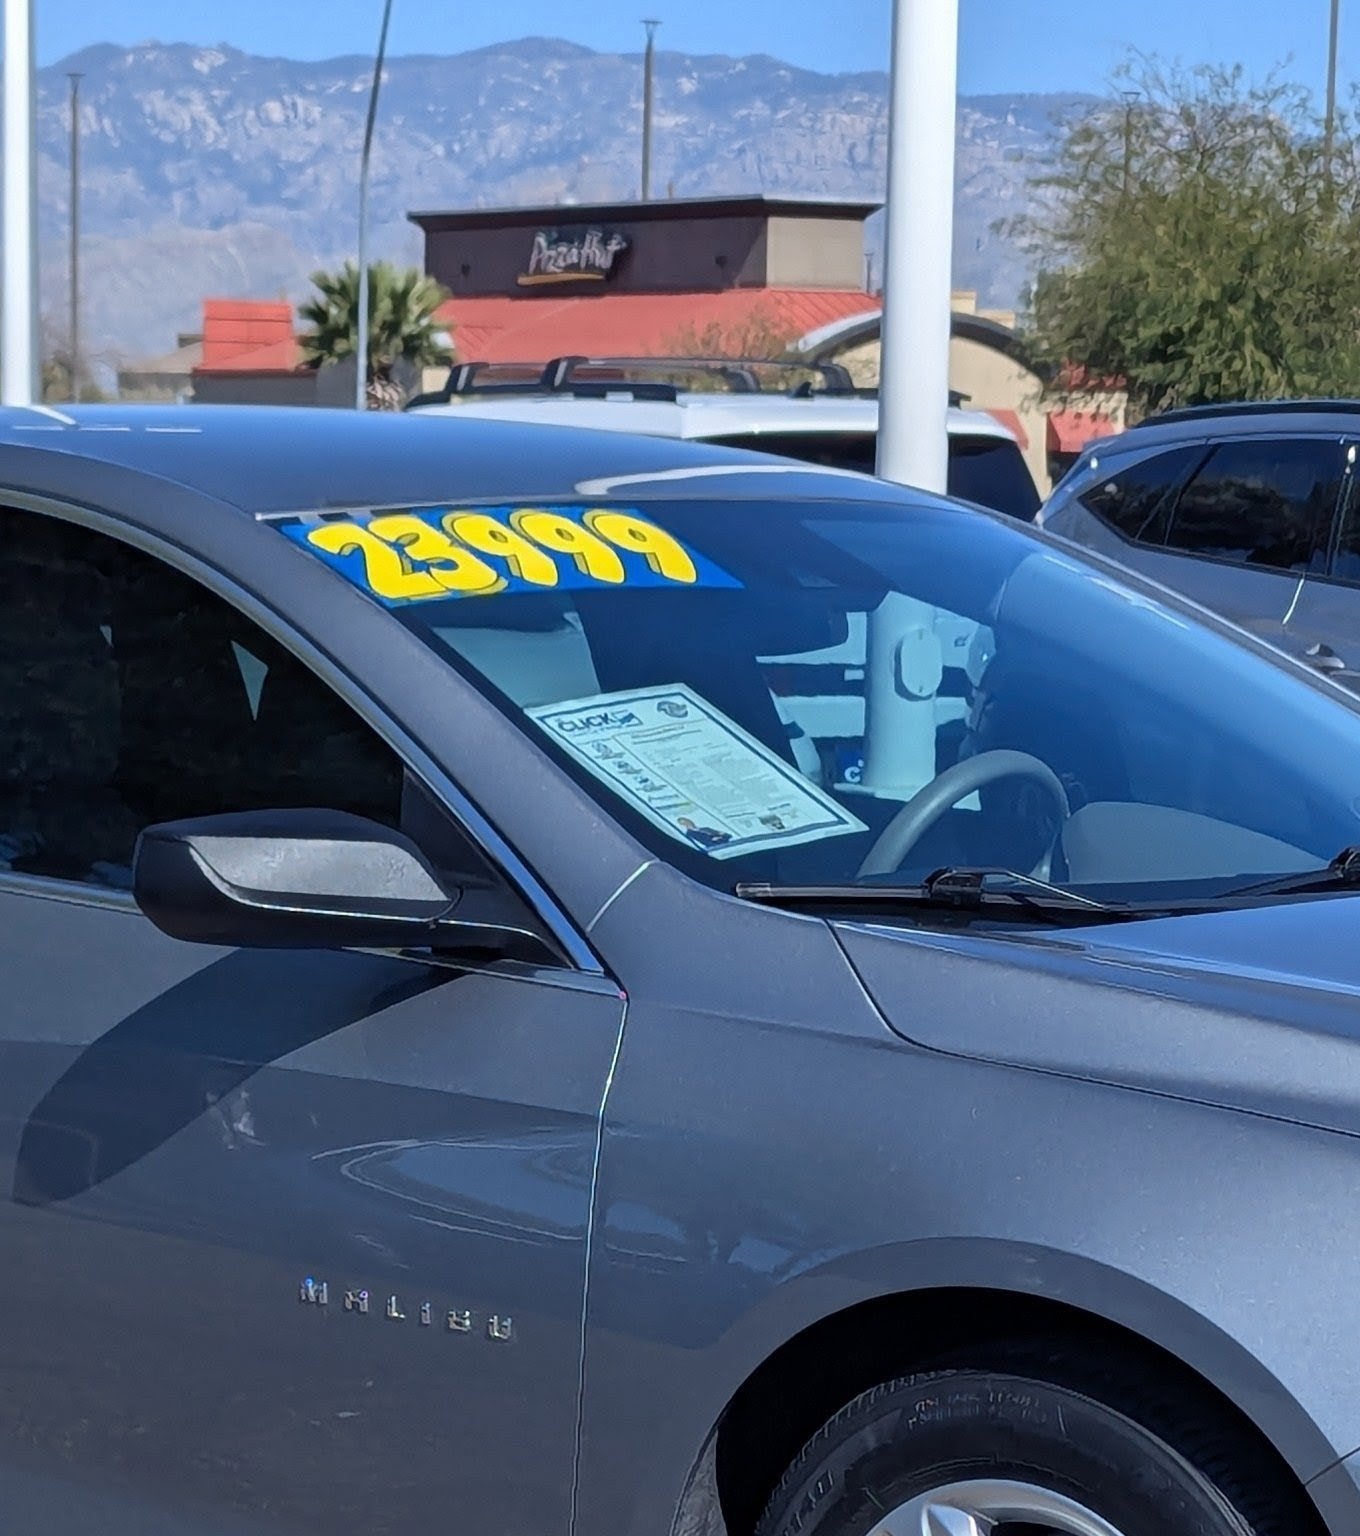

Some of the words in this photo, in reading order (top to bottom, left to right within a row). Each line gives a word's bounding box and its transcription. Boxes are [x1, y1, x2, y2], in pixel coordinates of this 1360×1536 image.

[580, 230, 627, 271] Hut
[307, 507, 699, 600] 23999
[300, 1276, 513, 1340] MALIBU
